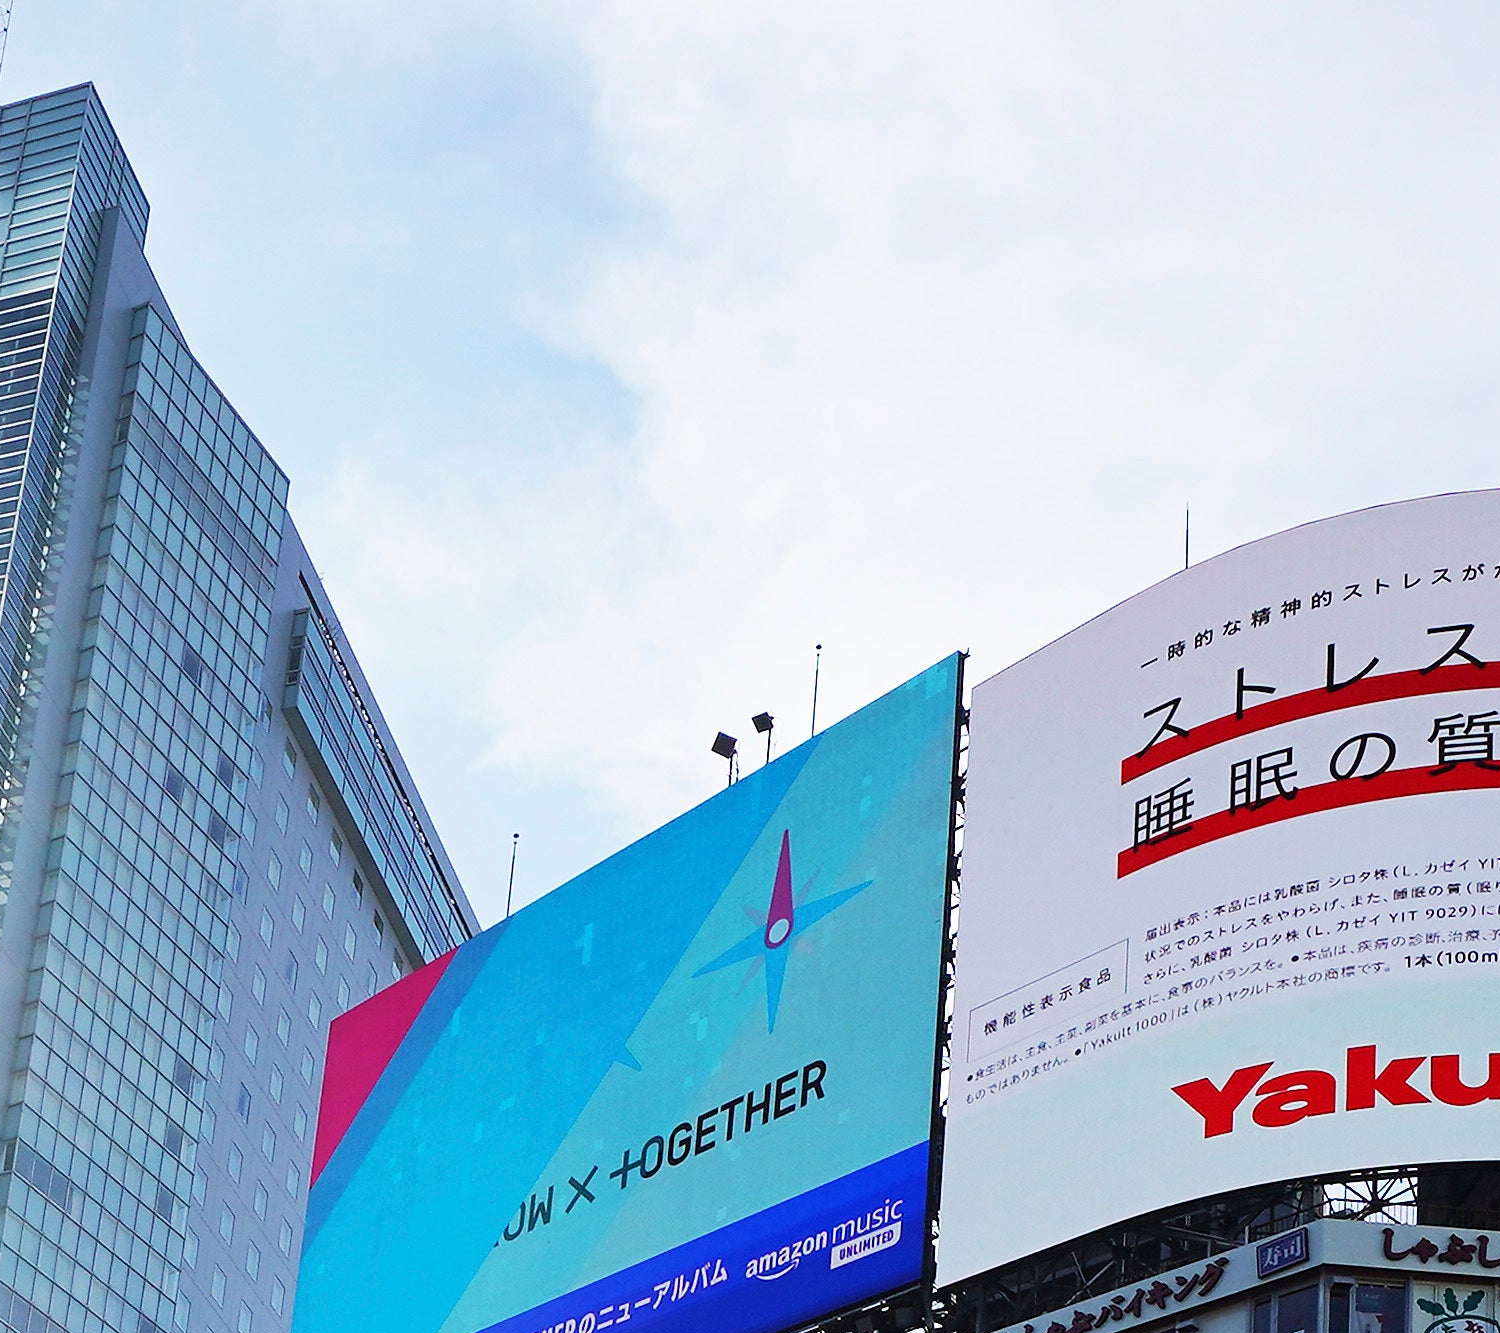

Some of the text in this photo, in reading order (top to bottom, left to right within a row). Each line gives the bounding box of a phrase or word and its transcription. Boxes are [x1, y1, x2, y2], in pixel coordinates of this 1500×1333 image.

[983, 968, 1113, 1038] 機能性表示食品
[745, 1199, 904, 1280] amazon music
[838, 1230, 895, 1261] UNLIMITED
